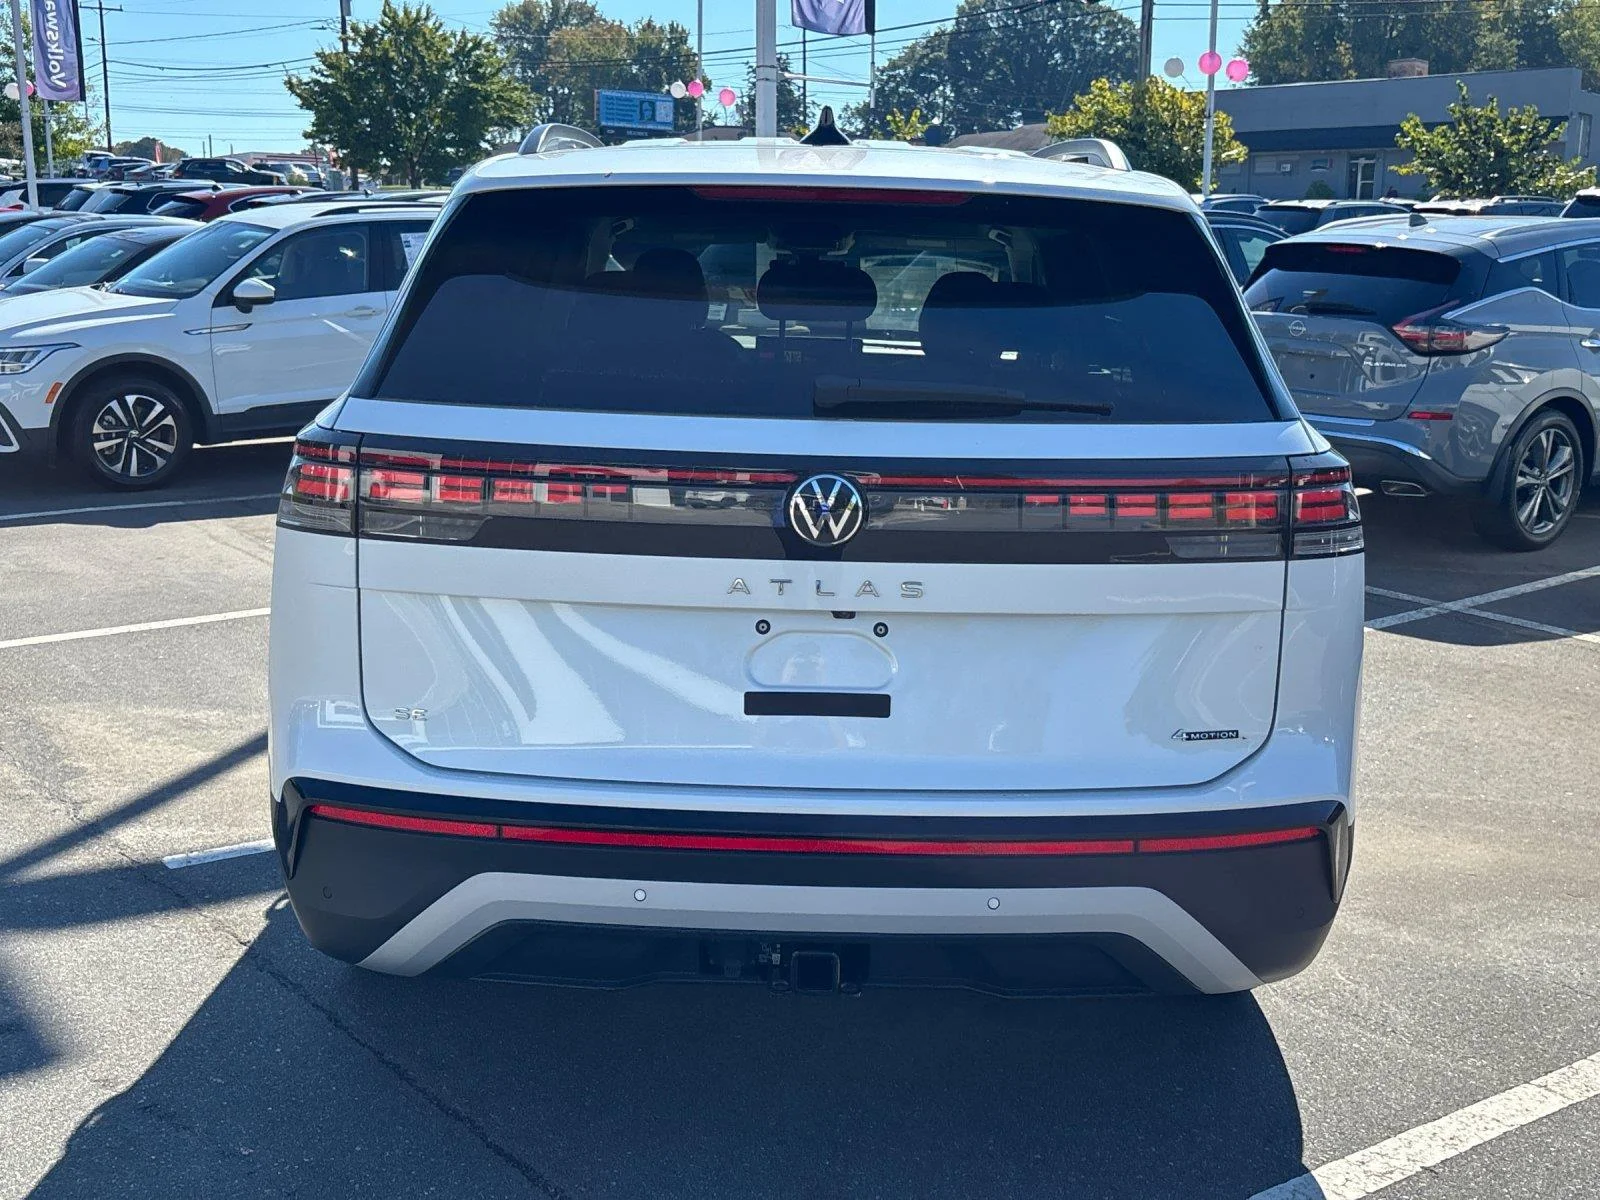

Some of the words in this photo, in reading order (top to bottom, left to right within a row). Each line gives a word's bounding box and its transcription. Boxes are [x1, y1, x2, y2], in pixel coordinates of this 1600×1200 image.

[792, 478, 861, 541] VW
[727, 577, 924, 599] ATLAS
[1171, 728, 1237, 741] 4MOTION
